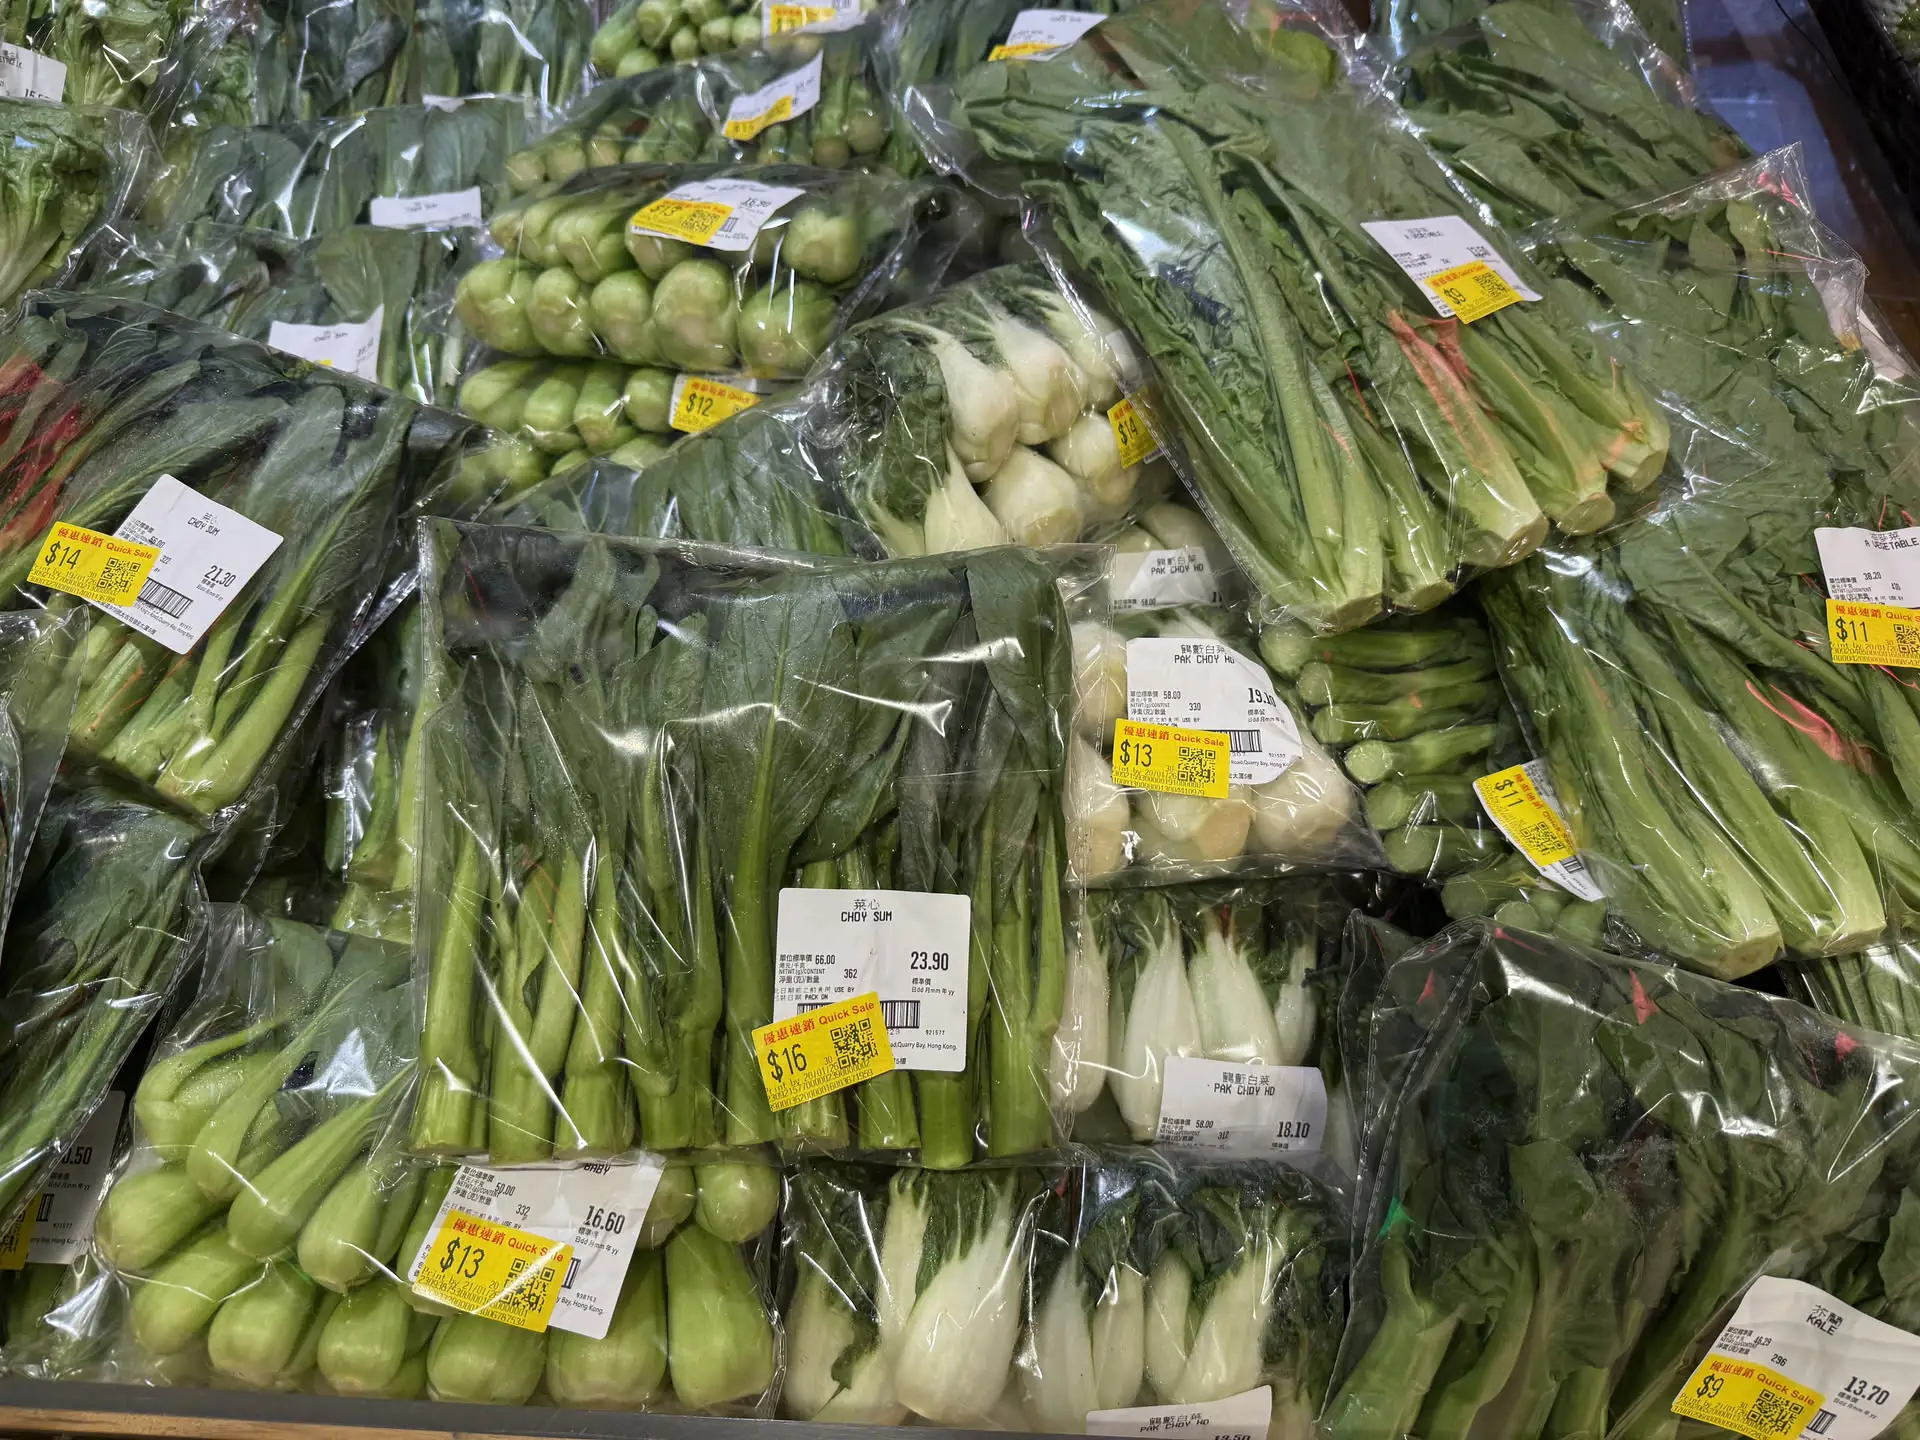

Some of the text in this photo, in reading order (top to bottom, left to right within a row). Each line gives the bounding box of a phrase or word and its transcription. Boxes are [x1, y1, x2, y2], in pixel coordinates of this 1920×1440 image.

[686, 392, 713, 417] $12
[1117, 416, 1138, 446] $14
[188, 517, 220, 537] CHOY SUM
[44, 540, 82, 570] $14
[106, 542, 132, 555] Quick
[134, 548, 153, 560] Sale
[203, 564, 238, 588] 21.30
[1151, 565, 1166, 575] PAK
[1170, 564, 1190, 574] CHOY
[1863, 572, 1882, 580] 38.20
[1886, 612, 1912, 620] Quick
[1835, 616, 1868, 642] $11
[1174, 654, 1191, 664] PAK
[1196, 654, 1219, 664] CHOY
[1164, 690, 1182, 700] 58.00
[1188, 702, 1201, 712] 330
[1124, 726, 1225, 747] 優惠速銷 Quick Sale
[1120, 738, 1153, 768] $13
[1494, 779, 1524, 808] $11
[854, 899, 880, 911] 菜心
[840, 911, 892, 922] CHOY SUM
[779, 954, 836, 965] 單位標準價 66.00
[910, 951, 949, 971] 23.90
[844, 968, 858, 979] 362
[912, 978, 932, 986] 標準價
[763, 1000, 875, 1046] 優惠速銷 Quick Sale
[767, 1043, 808, 1084] $16
[824, 1056, 833, 1064] 30
[790, 1078, 800, 1089] by
[804, 1062, 840, 1081] 20/01/26
[1214, 1082, 1276, 1096] PAK CHOY HO
[1196, 1120, 1214, 1129] 58.00
[1276, 1120, 1310, 1139] 18.10
[1218, 1130, 1230, 1140] 312
[516, 1204, 531, 1216] 332
[584, 1204, 626, 1234] 16.60
[452, 1218, 506, 1246] 優惠速銷
[508, 1238, 538, 1255] Quick
[440, 1237, 485, 1279] $13
[420, 1267, 446, 1282] Print
[450, 1278, 462, 1292] by
[488, 1280, 500, 1290] 20
[572, 1300, 588, 1312] Hong
[1806, 1314, 1838, 1336] KALE
[1770, 1353, 1788, 1367] 296
[1696, 1373, 1724, 1399] $9
[1756, 1373, 1789, 1396] Quick
[1790, 1389, 1816, 1407] Sale
[1843, 1376, 1890, 1406] 13.70
[1140, 1418, 1210, 1432] PAK CHOY HO
